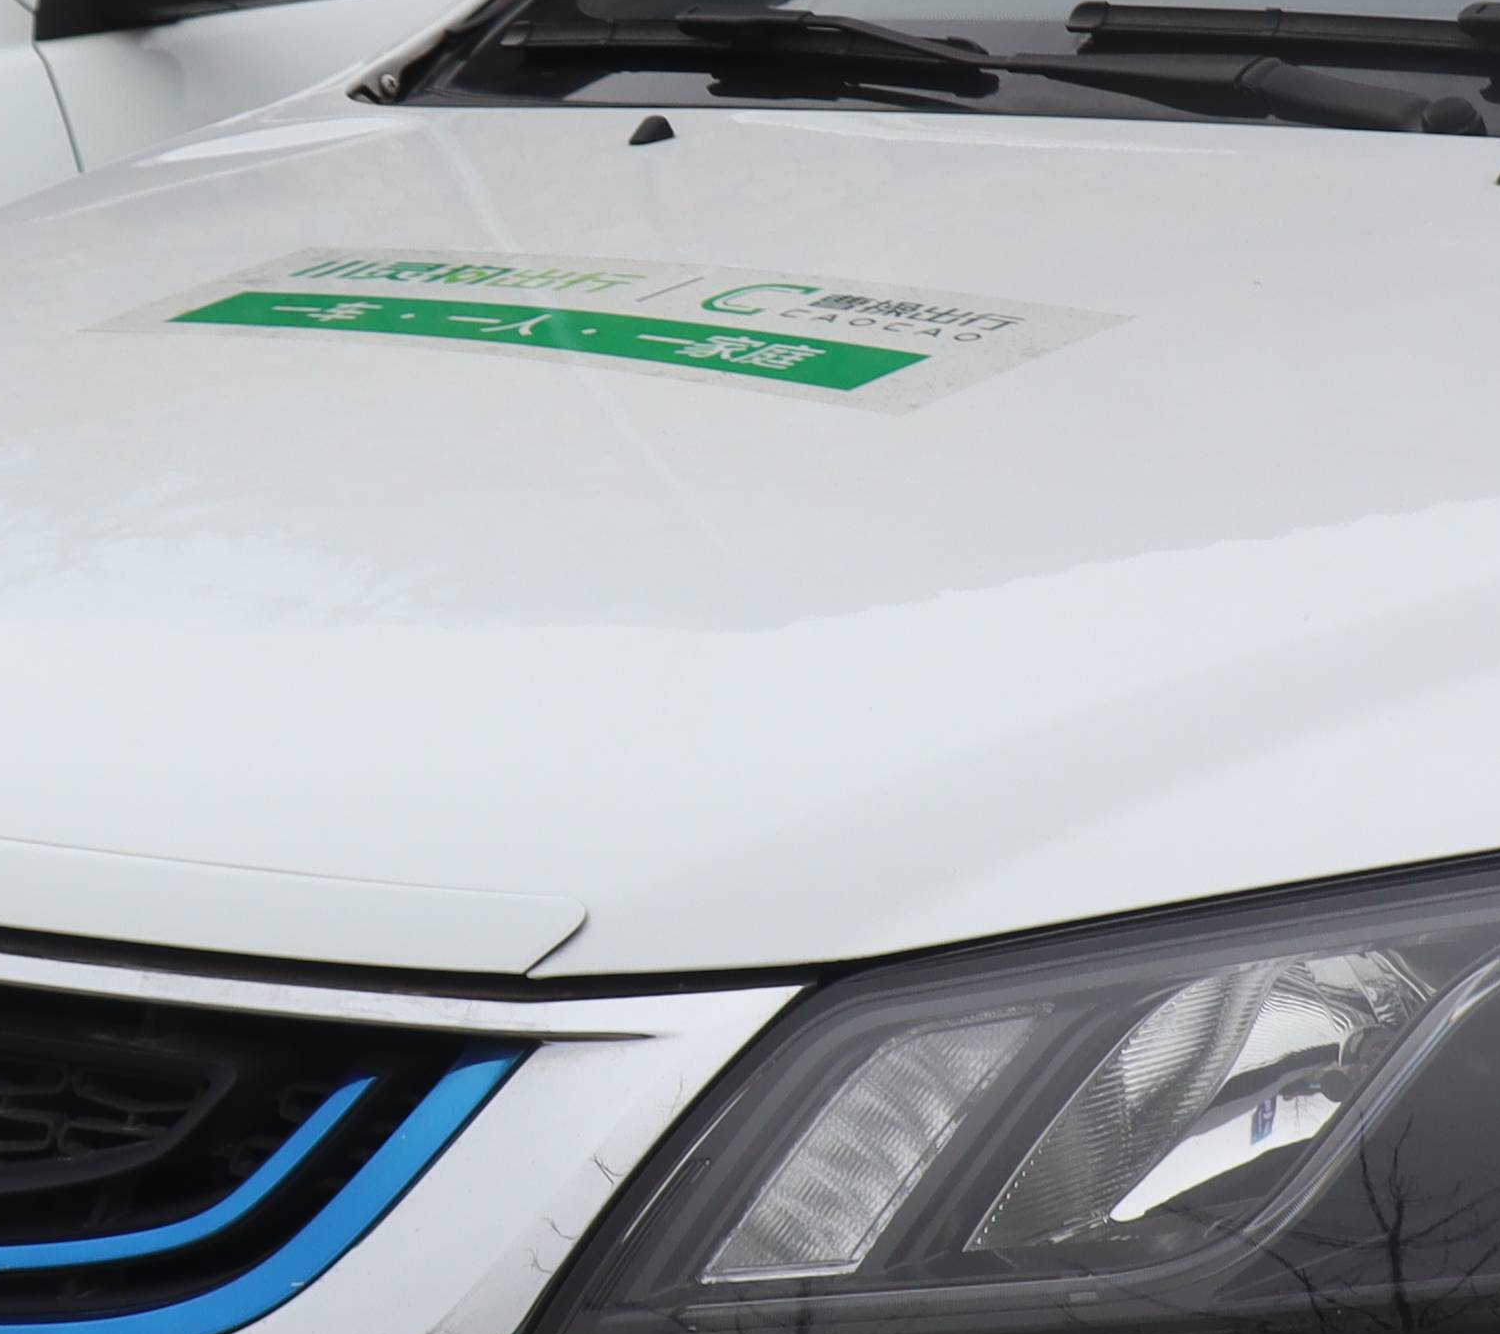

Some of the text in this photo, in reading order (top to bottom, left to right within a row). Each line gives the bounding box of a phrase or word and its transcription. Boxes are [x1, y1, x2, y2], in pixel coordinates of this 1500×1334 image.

[780, 309, 984, 343] CAOCAO
[809, 293, 1027, 331] 曹操出行
